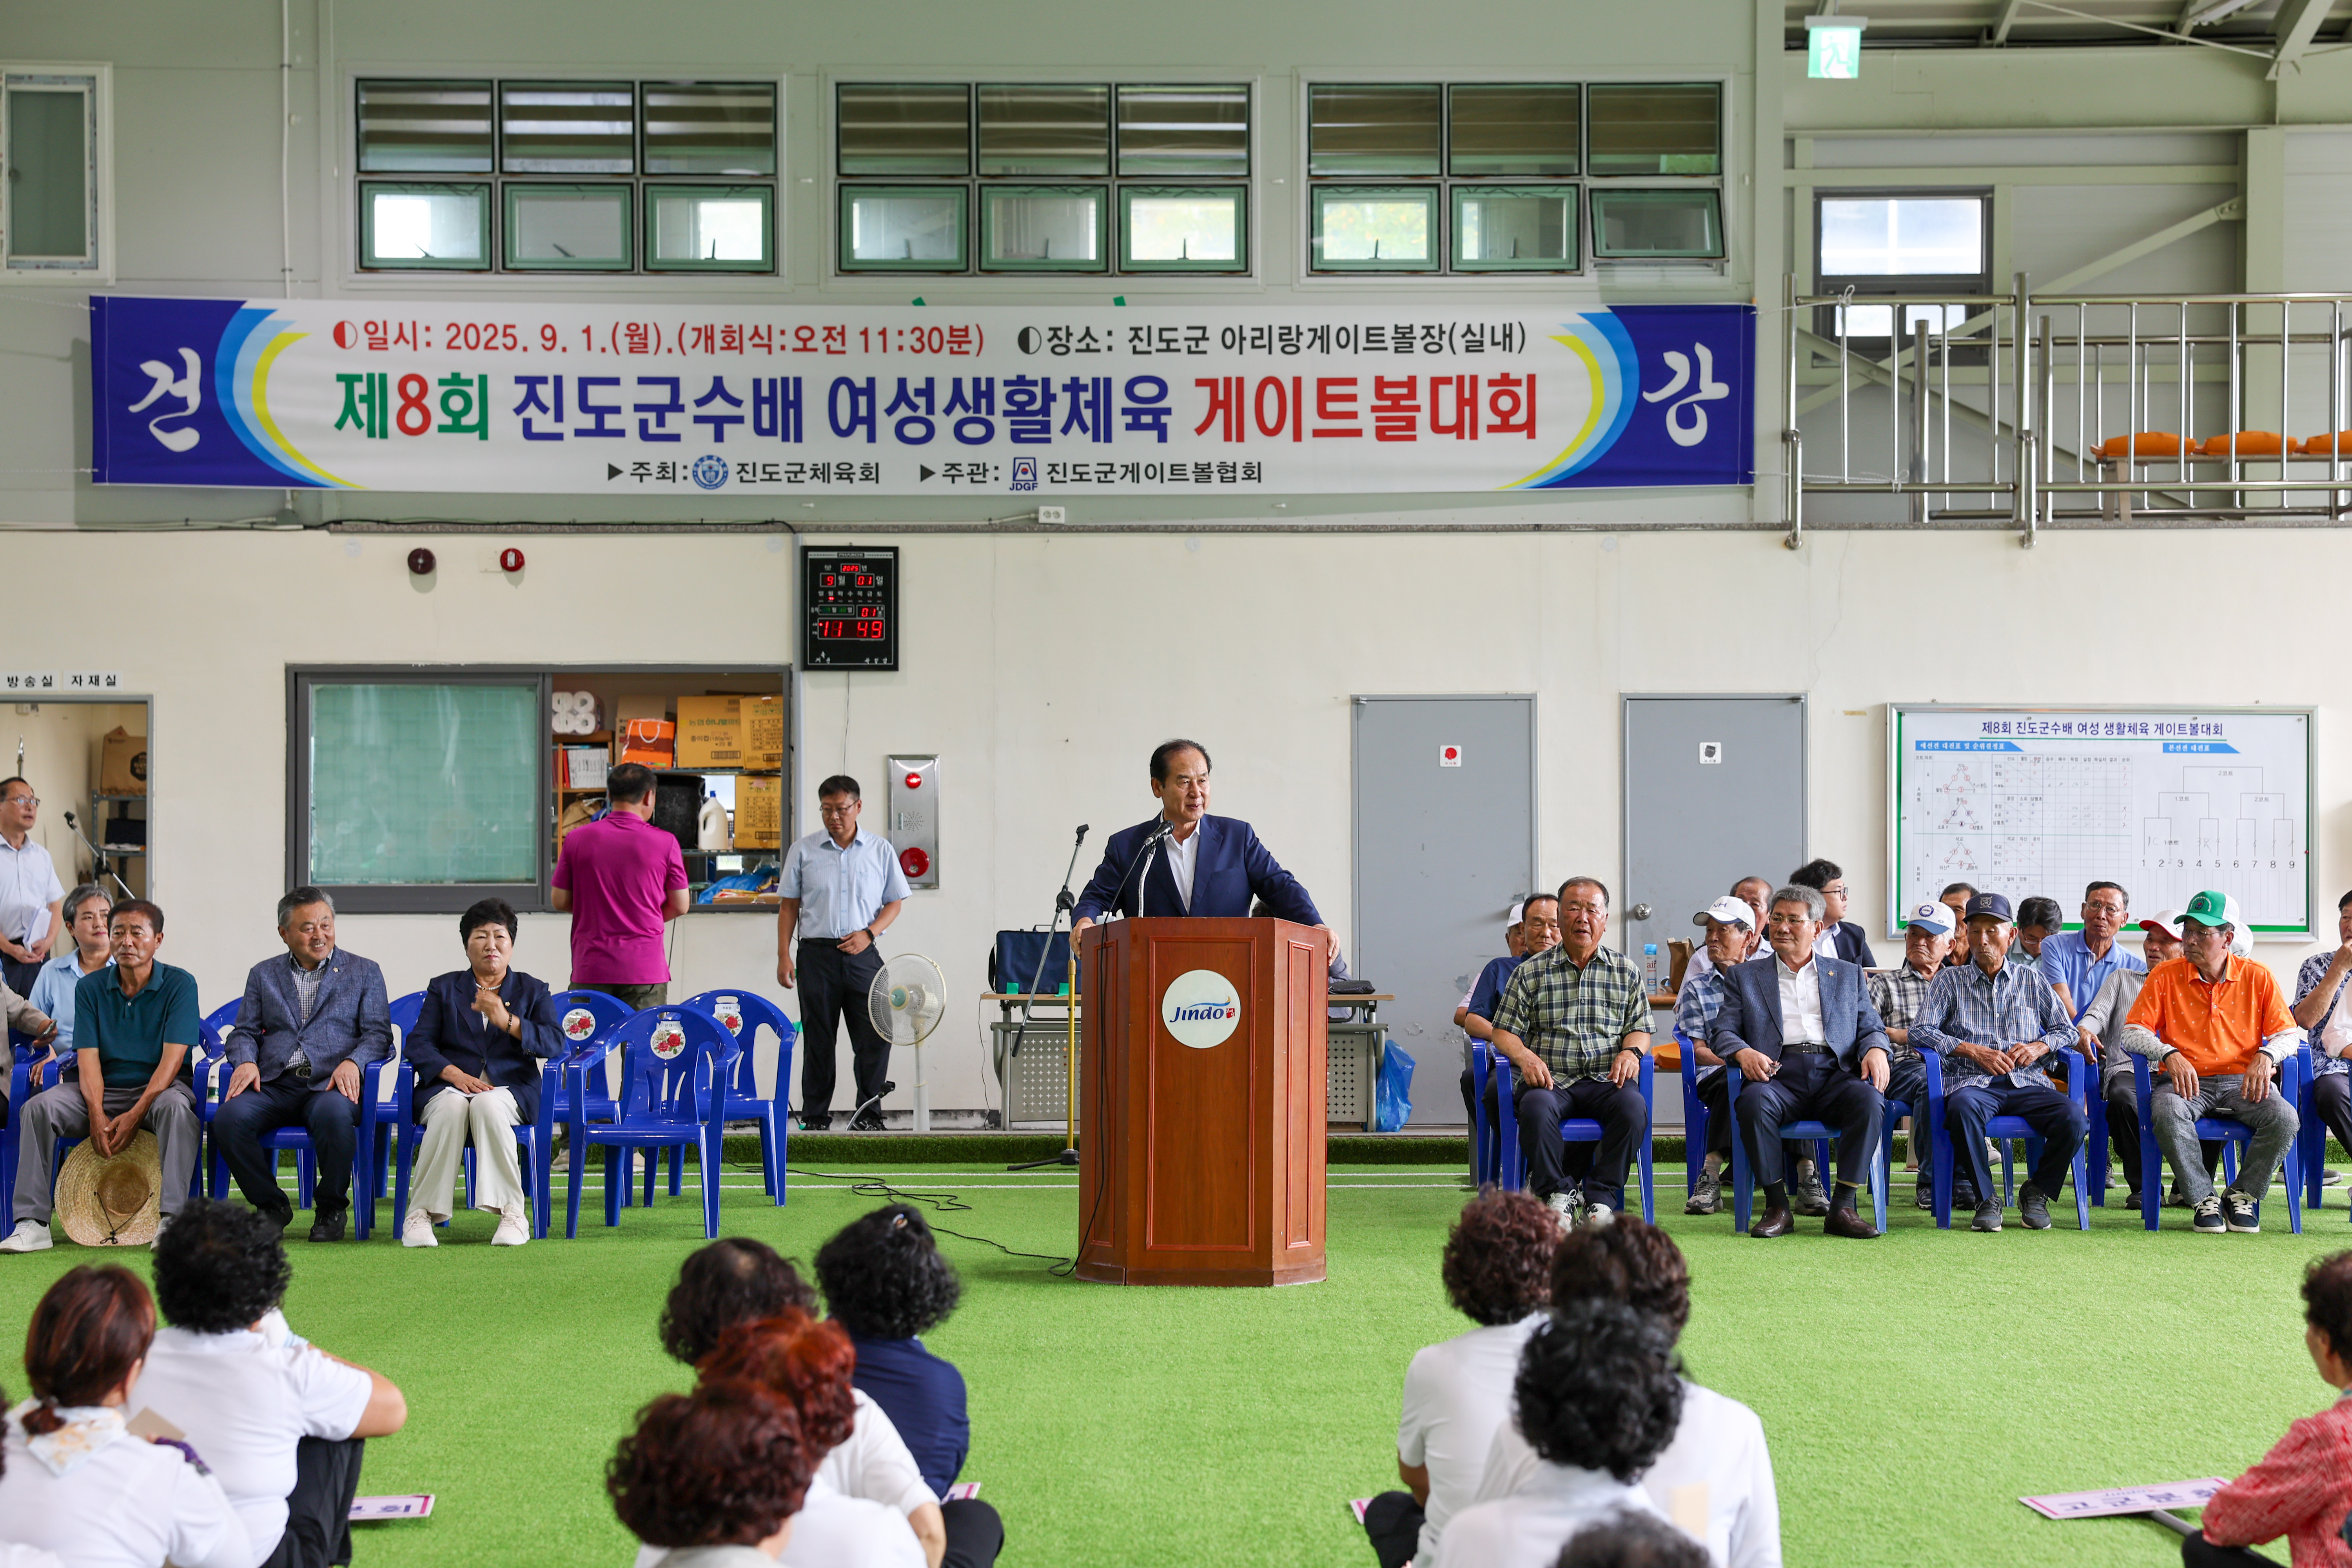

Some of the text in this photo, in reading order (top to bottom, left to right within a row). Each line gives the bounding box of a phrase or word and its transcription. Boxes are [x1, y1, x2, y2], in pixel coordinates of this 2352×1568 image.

[364, 319, 432, 351] 일시:
[445, 322, 528, 353] 2025.
[540, 323, 567, 353] 9.
[860, 324, 984, 357] 11:30분)
[1047, 321, 1526, 356] 장소: 진도군 아리랑게이트볼장(실내)
[127, 347, 201, 452] 건
[1642, 341, 1730, 447] 강
[334, 372, 1536, 445] 제8회 진도군수배 여성생활체육 게이트볼대회
[630, 461, 689, 484] 주최:
[735, 461, 880, 485] 진도군체육회
[942, 462, 1263, 485] 주관: 진도군게이트볼협회
[1009, 482, 1038, 491] JDGF
[827, 575, 834, 586] 9
[857, 575, 873, 586] 01
[861, 607, 877, 617] 01
[7, 675, 53, 688] 방송실
[71, 674, 116, 687] 자재실
[1982, 721, 2223, 737] 제8회 진도군수배 여성 생활체육 게이트볼대회
[2158, 859, 2164, 867] 2
[2178, 859, 2295, 869] 3 4 5 6 7 8 9
[1169, 1006, 1224, 1023] Jindo
